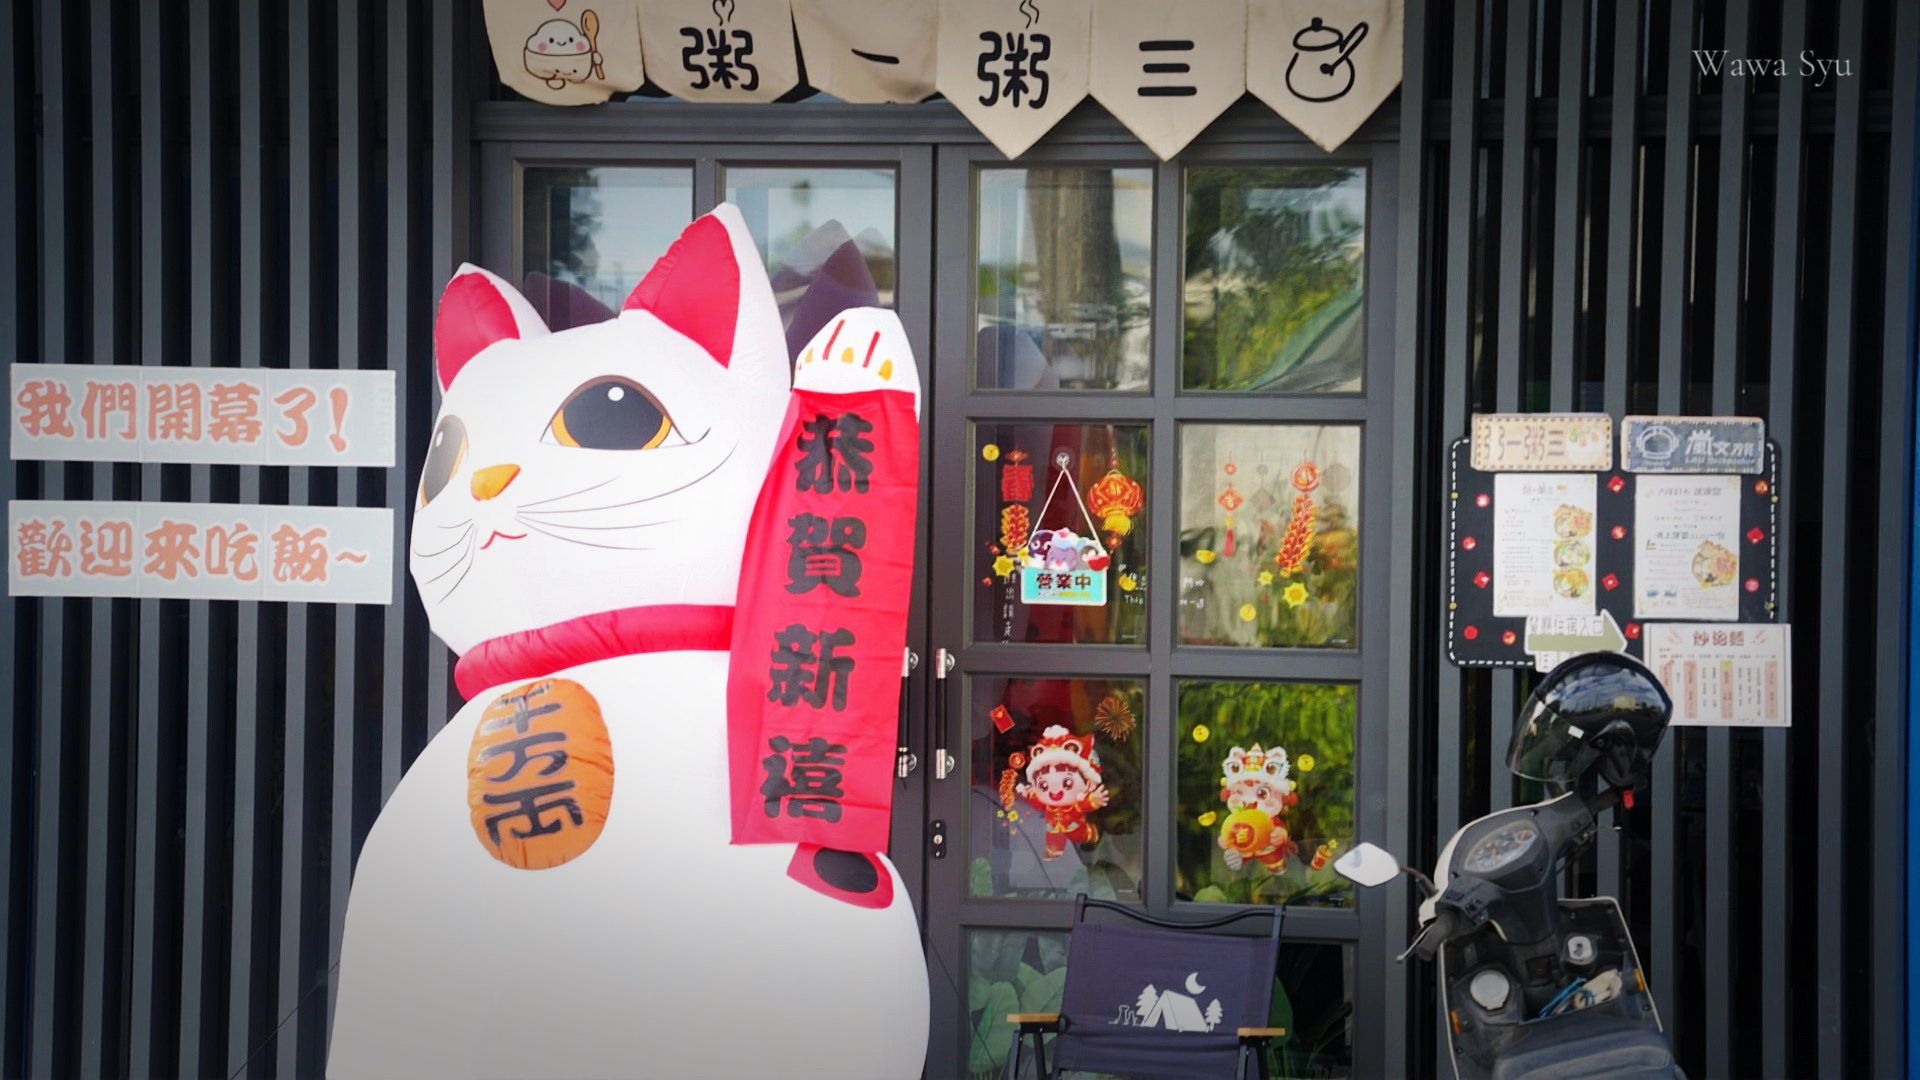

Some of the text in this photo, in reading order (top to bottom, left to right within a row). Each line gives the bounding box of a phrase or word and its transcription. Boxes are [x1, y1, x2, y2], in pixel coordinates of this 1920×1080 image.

[681, 27, 1197, 109] 粥一粥三
[16, 380, 348, 452] 我們開幕了!
[16, 519, 367, 582] 歡迎來吃飯~
[1036, 573, 1091, 590] 營業中
[760, 412, 875, 823] 恭賀新禧
